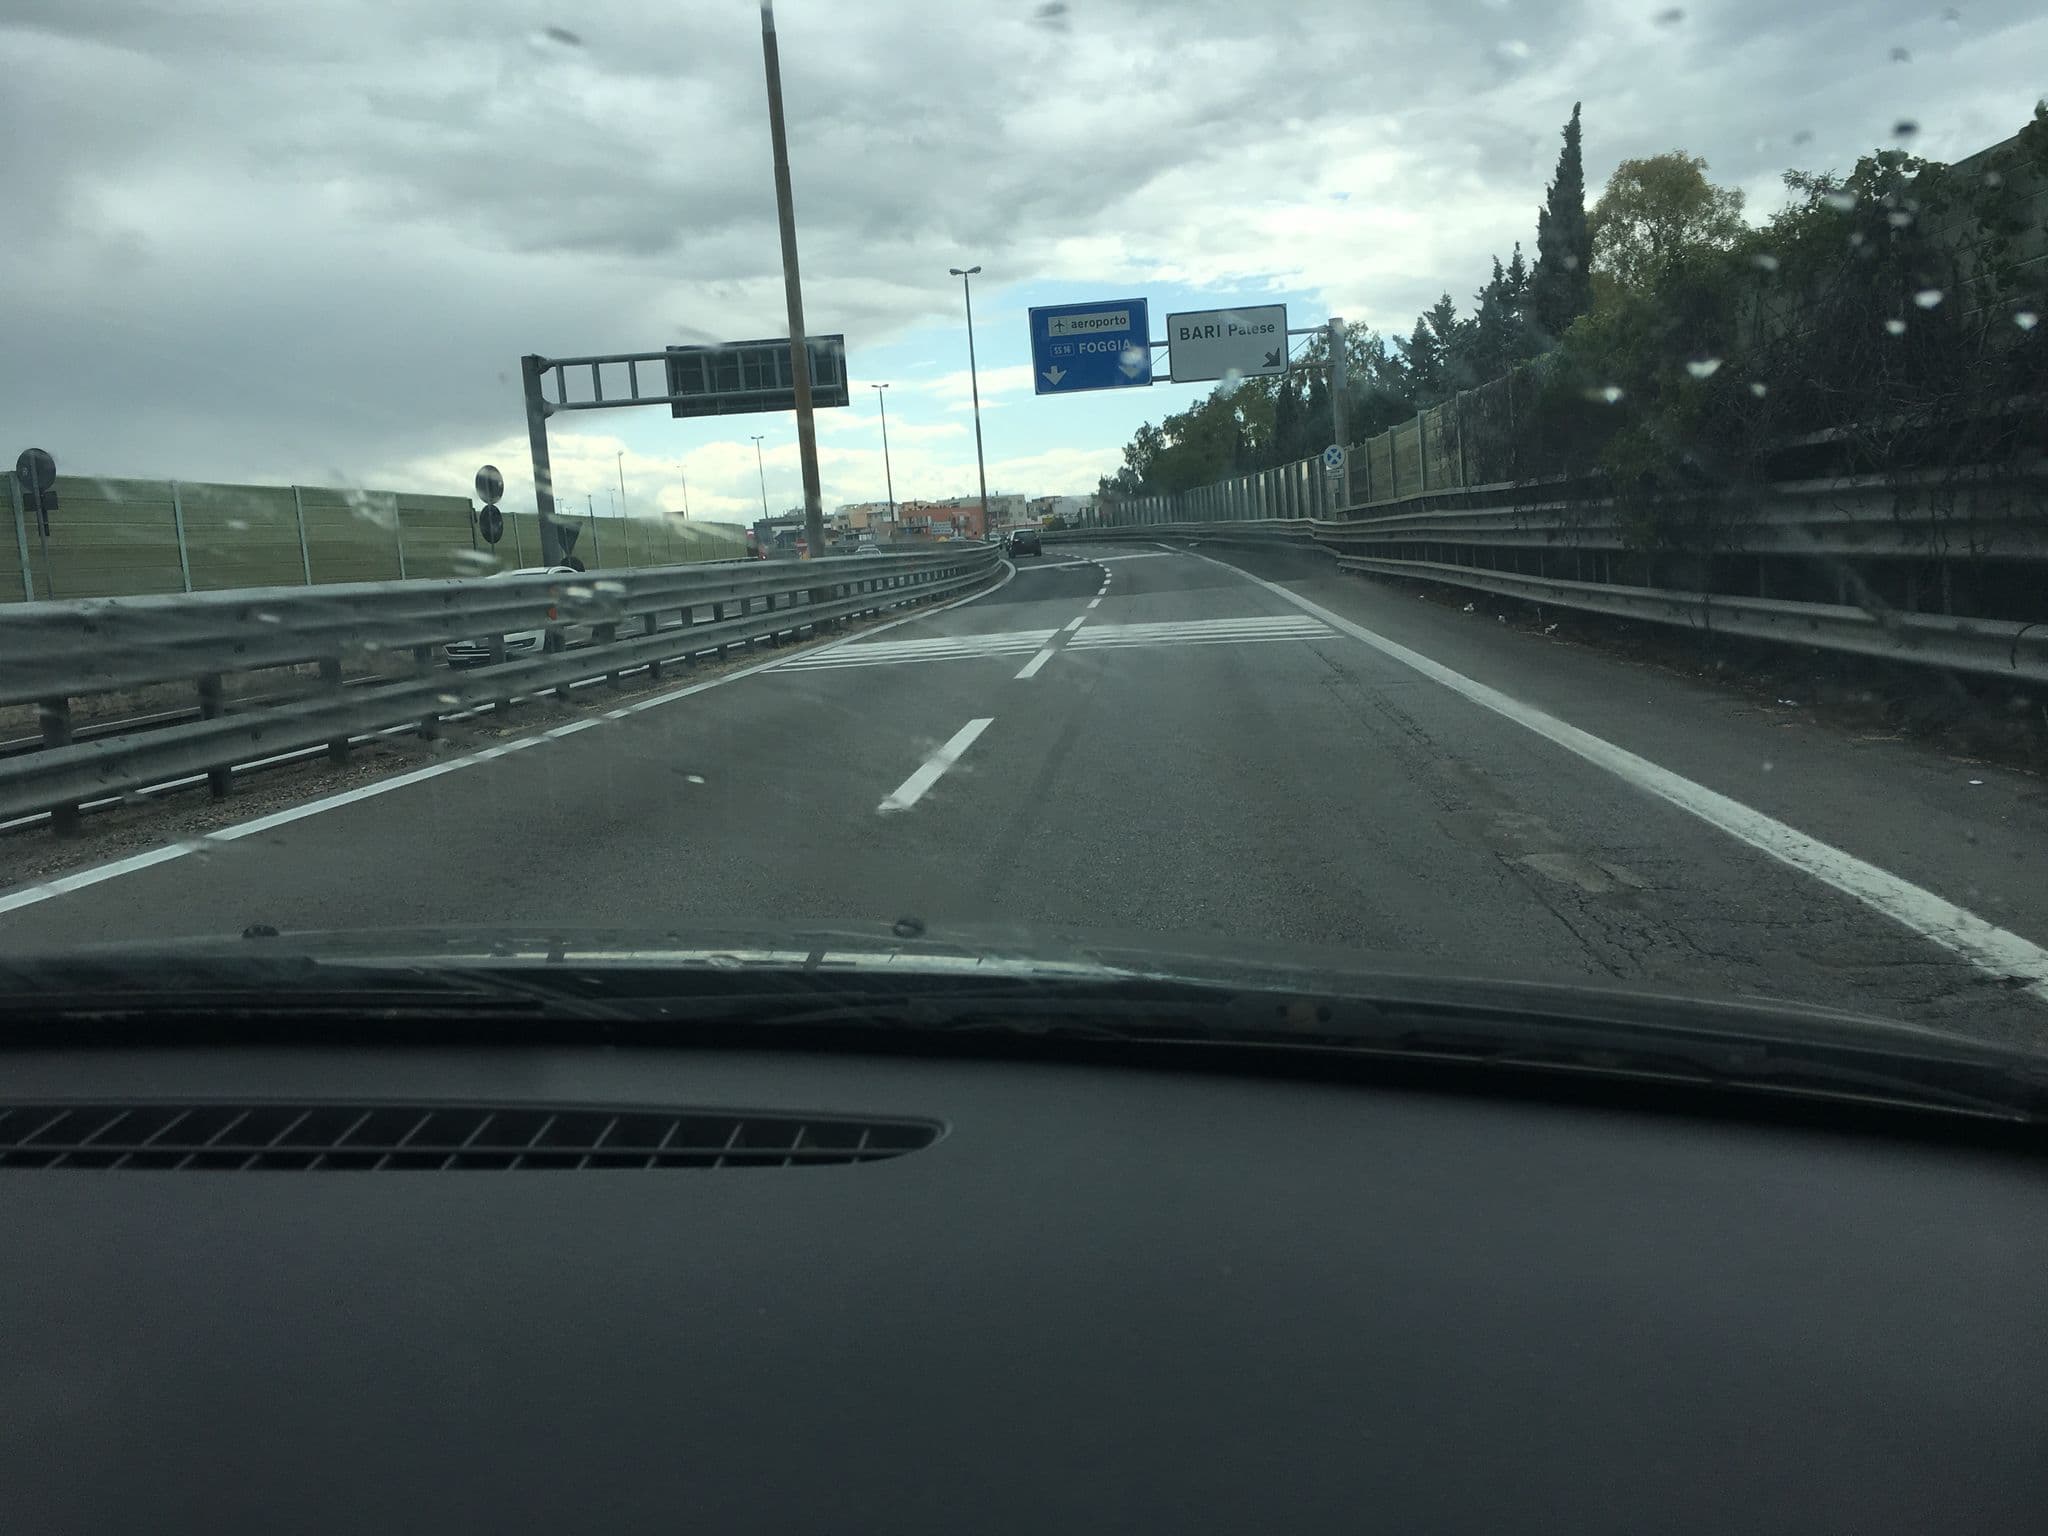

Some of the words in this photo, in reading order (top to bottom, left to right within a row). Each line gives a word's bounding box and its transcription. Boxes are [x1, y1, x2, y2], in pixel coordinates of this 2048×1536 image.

[1071, 315, 1127, 329] aeroporto
[1180, 325, 1221, 341] BARI
[1079, 340, 1131, 354] FOGGIA
